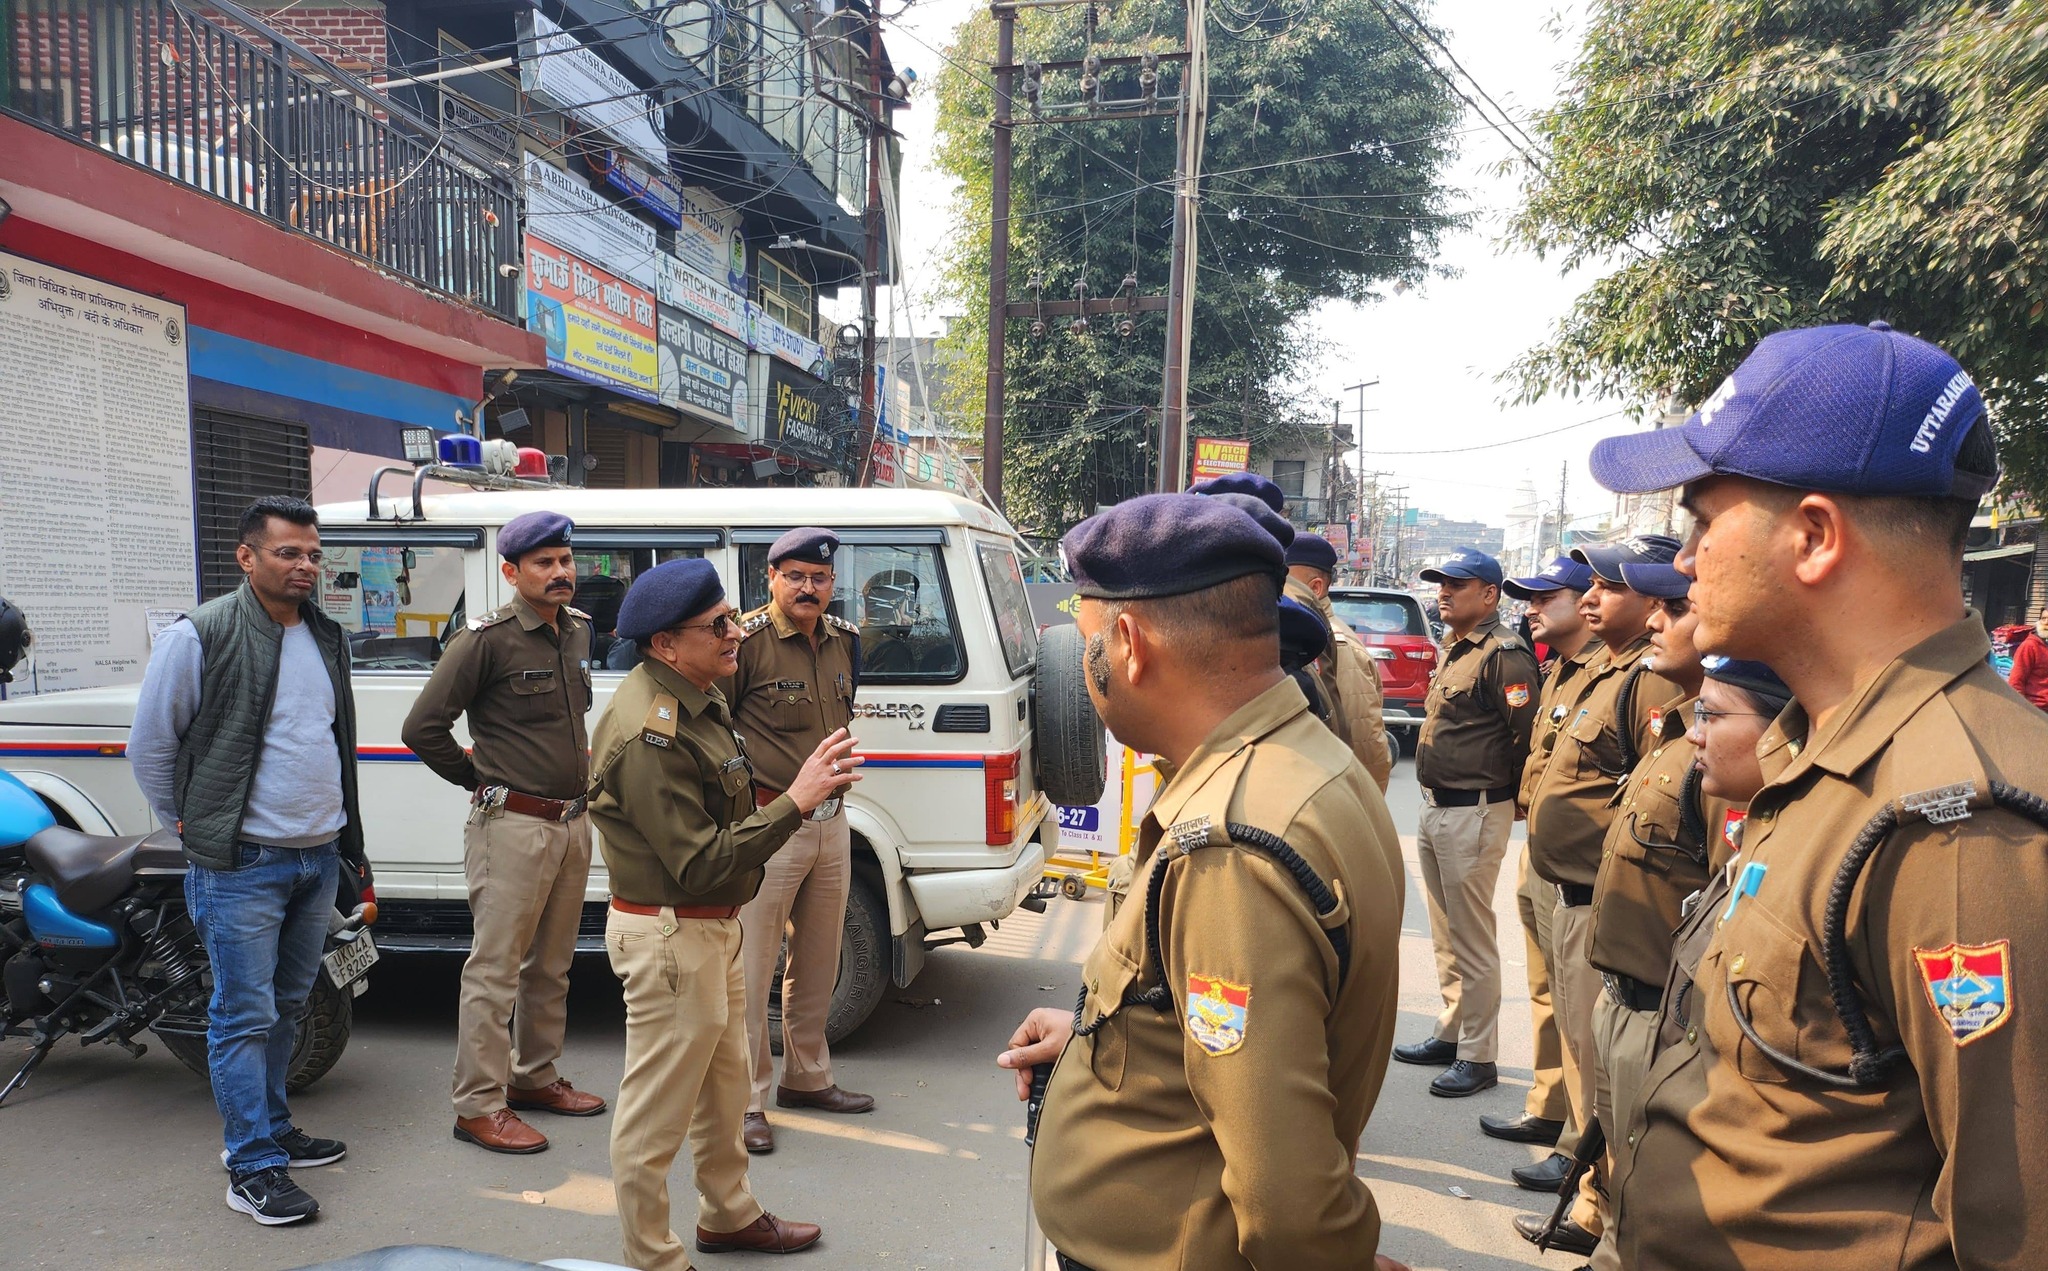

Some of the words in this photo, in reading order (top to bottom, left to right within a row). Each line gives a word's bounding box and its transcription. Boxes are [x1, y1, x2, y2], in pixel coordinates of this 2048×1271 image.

[552, 28, 606, 78] ABHILASHA
[609, 75, 653, 109] ADVOCAT
[544, 168, 598, 209] ABHILASHA
[601, 202, 645, 236] ADVOCATE
[699, 208, 724, 238] STUDY
[13, 268, 36, 288] जिला
[39, 276, 68, 296] विधिक
[70, 285, 86, 302] सेवा
[530, 248, 570, 290] कुमाऊँ
[602, 282, 632, 320] मशीन
[634, 294, 654, 330] स्टोर
[672, 264, 706, 296] WATCH
[709, 285, 736, 311] Wrld
[38, 298, 74, 320] अभियुक्त
[84, 310, 99, 326] बंदी
[102, 312, 110, 327] के
[113, 318, 144, 336] अधिकार
[689, 289, 729, 320] ELECTRONICS
[659, 314, 691, 351] हल्द्वानी
[693, 331, 711, 360] एयर
[712, 341, 726, 368] गन
[728, 348, 746, 377] हाउस
[772, 324, 785, 347] LET'S
[786, 333, 803, 357] STUDY
[790, 392, 820, 425] VICKY
[786, 418, 818, 446] FASHION
[1203, 460, 1245, 469] ELECTRONICS
[112, 659, 130, 667] Helpline
[909, 721, 925, 730] LX
[1921, 800, 1972, 824] पुलिस
[1068, 830, 1083, 840] Class
[1083, 832, 1089, 840] IX
[1178, 830, 1209, 854] पुलिस
[340, 950, 373, 982] F8205
